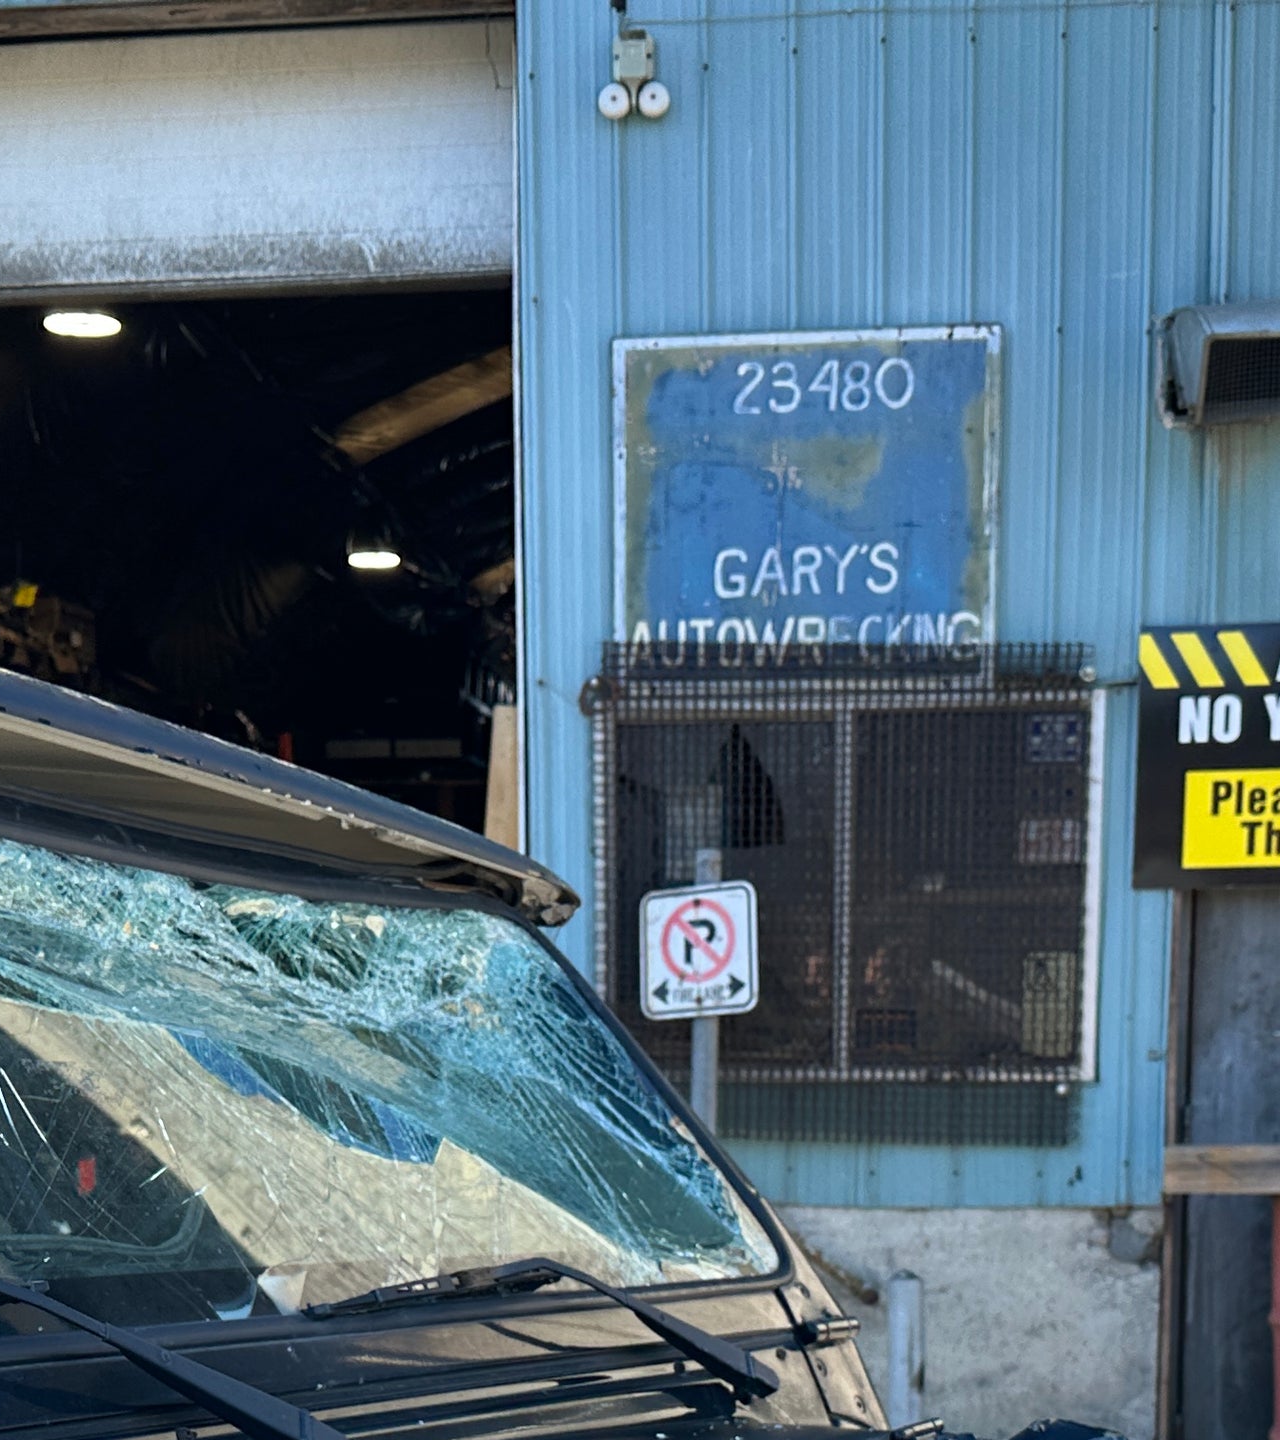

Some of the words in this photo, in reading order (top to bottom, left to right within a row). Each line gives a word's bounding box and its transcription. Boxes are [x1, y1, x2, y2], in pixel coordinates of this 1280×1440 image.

[732, 356, 916, 415] 23480
[713, 541, 900, 599] GARY'S
[1177, 695, 1243, 744] NO
